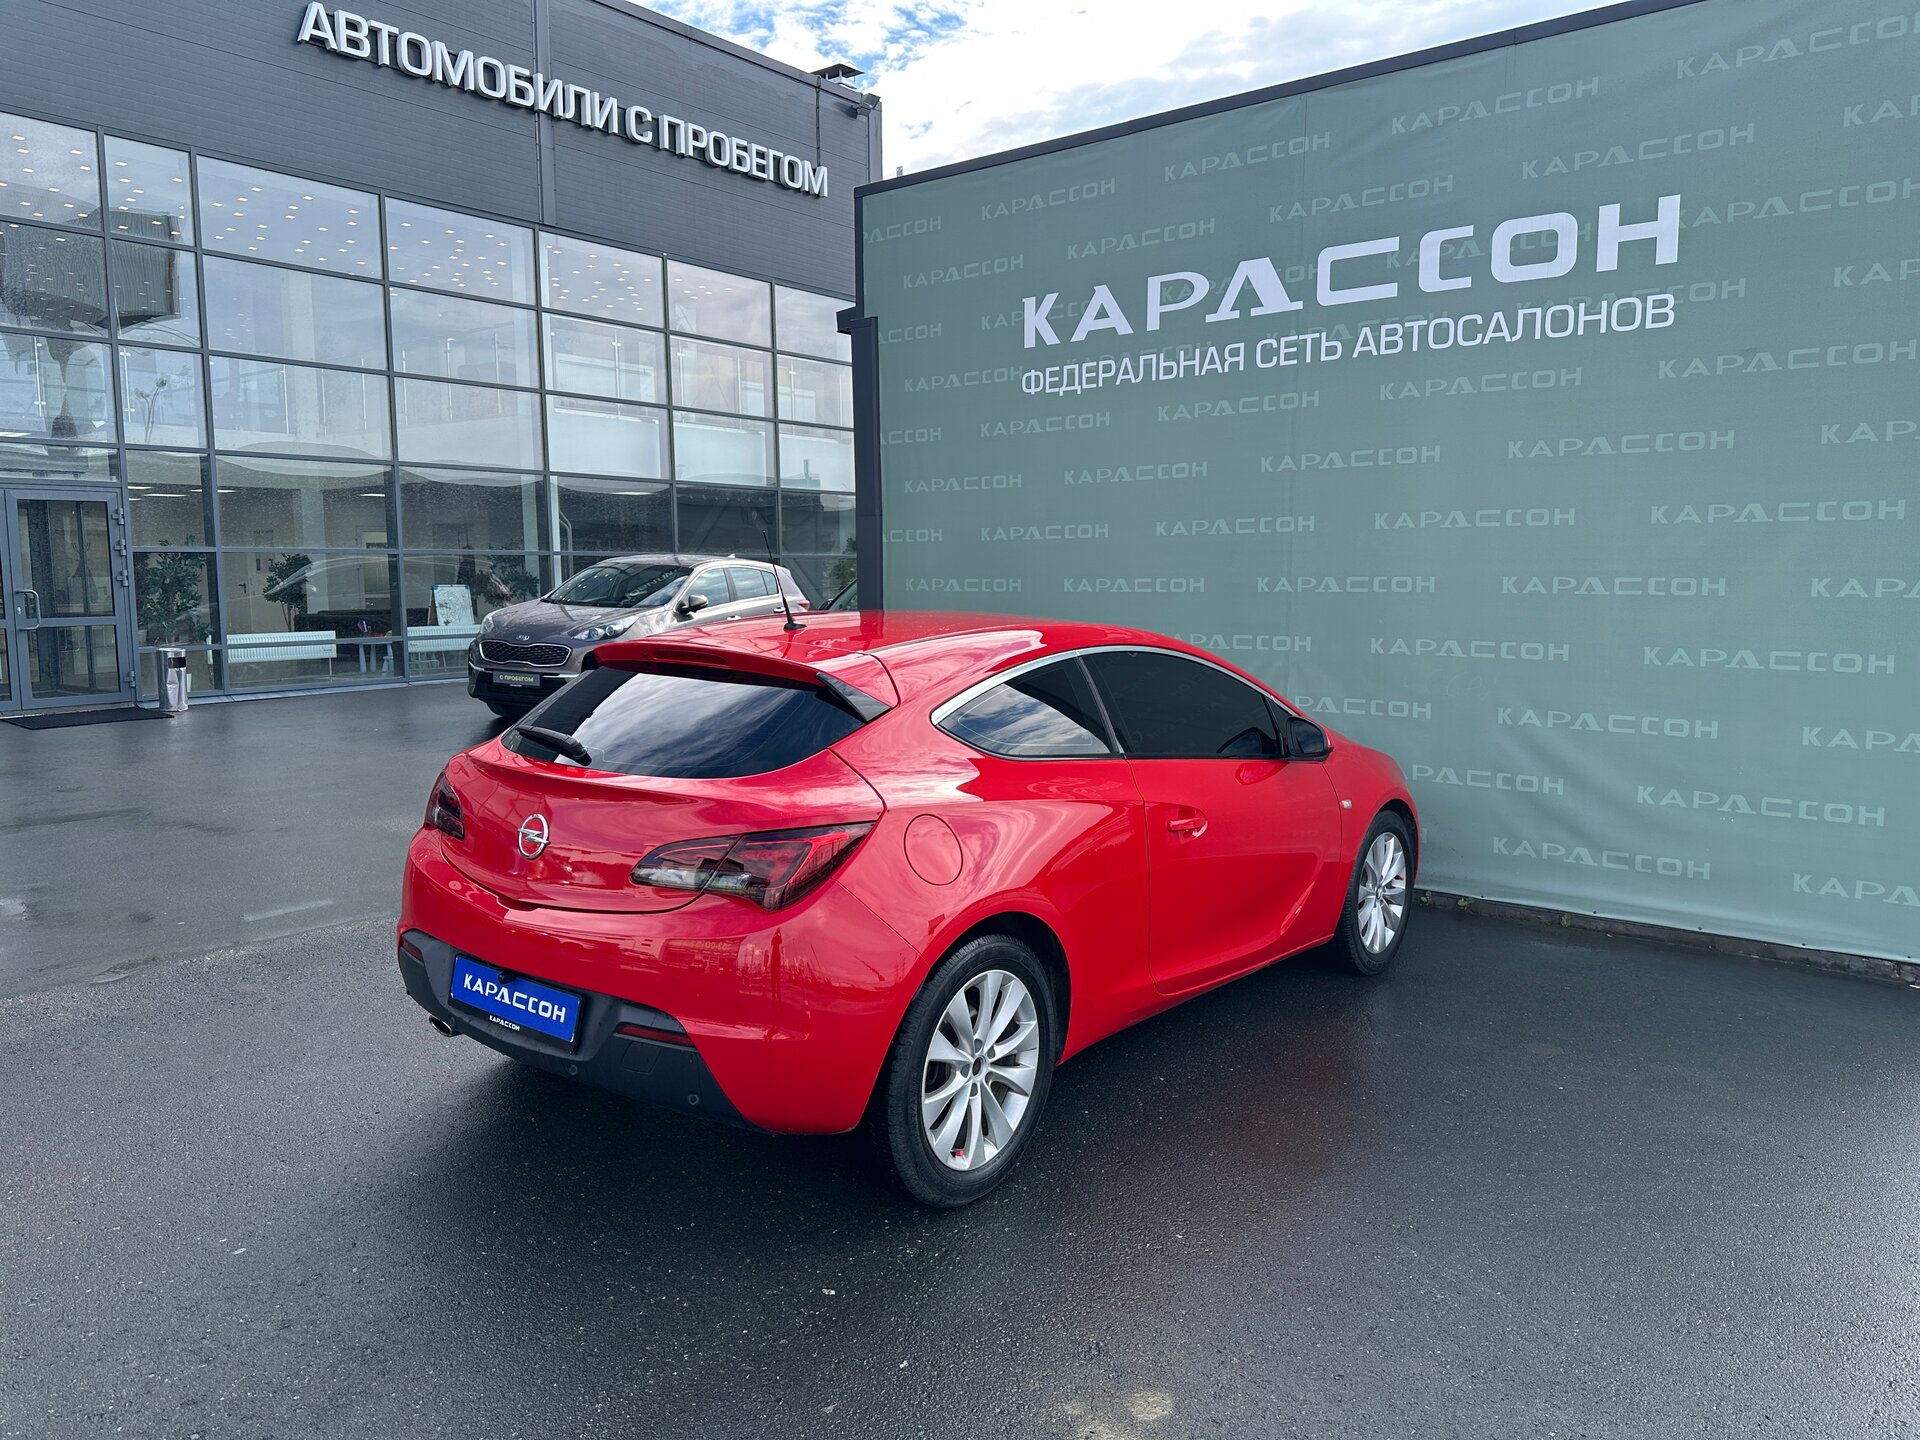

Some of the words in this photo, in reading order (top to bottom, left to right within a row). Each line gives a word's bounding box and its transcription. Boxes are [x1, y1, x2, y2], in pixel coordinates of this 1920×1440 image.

[1676, 11, 1920, 79] КАРЛССО
[298, 1, 618, 134] АВТОМОБИЛИ
[624, 104, 653, 143] С
[658, 115, 828, 197] ПРОБЕГОМ
[1021, 342, 1245, 396] ФЕДЕРАЛЬНАЯ
[1255, 331, 1343, 369] СЕТЬ
[1352, 293, 1676, 358] АВТОСАЛОНОВ
[1820, 420, 1920, 444] КАР
